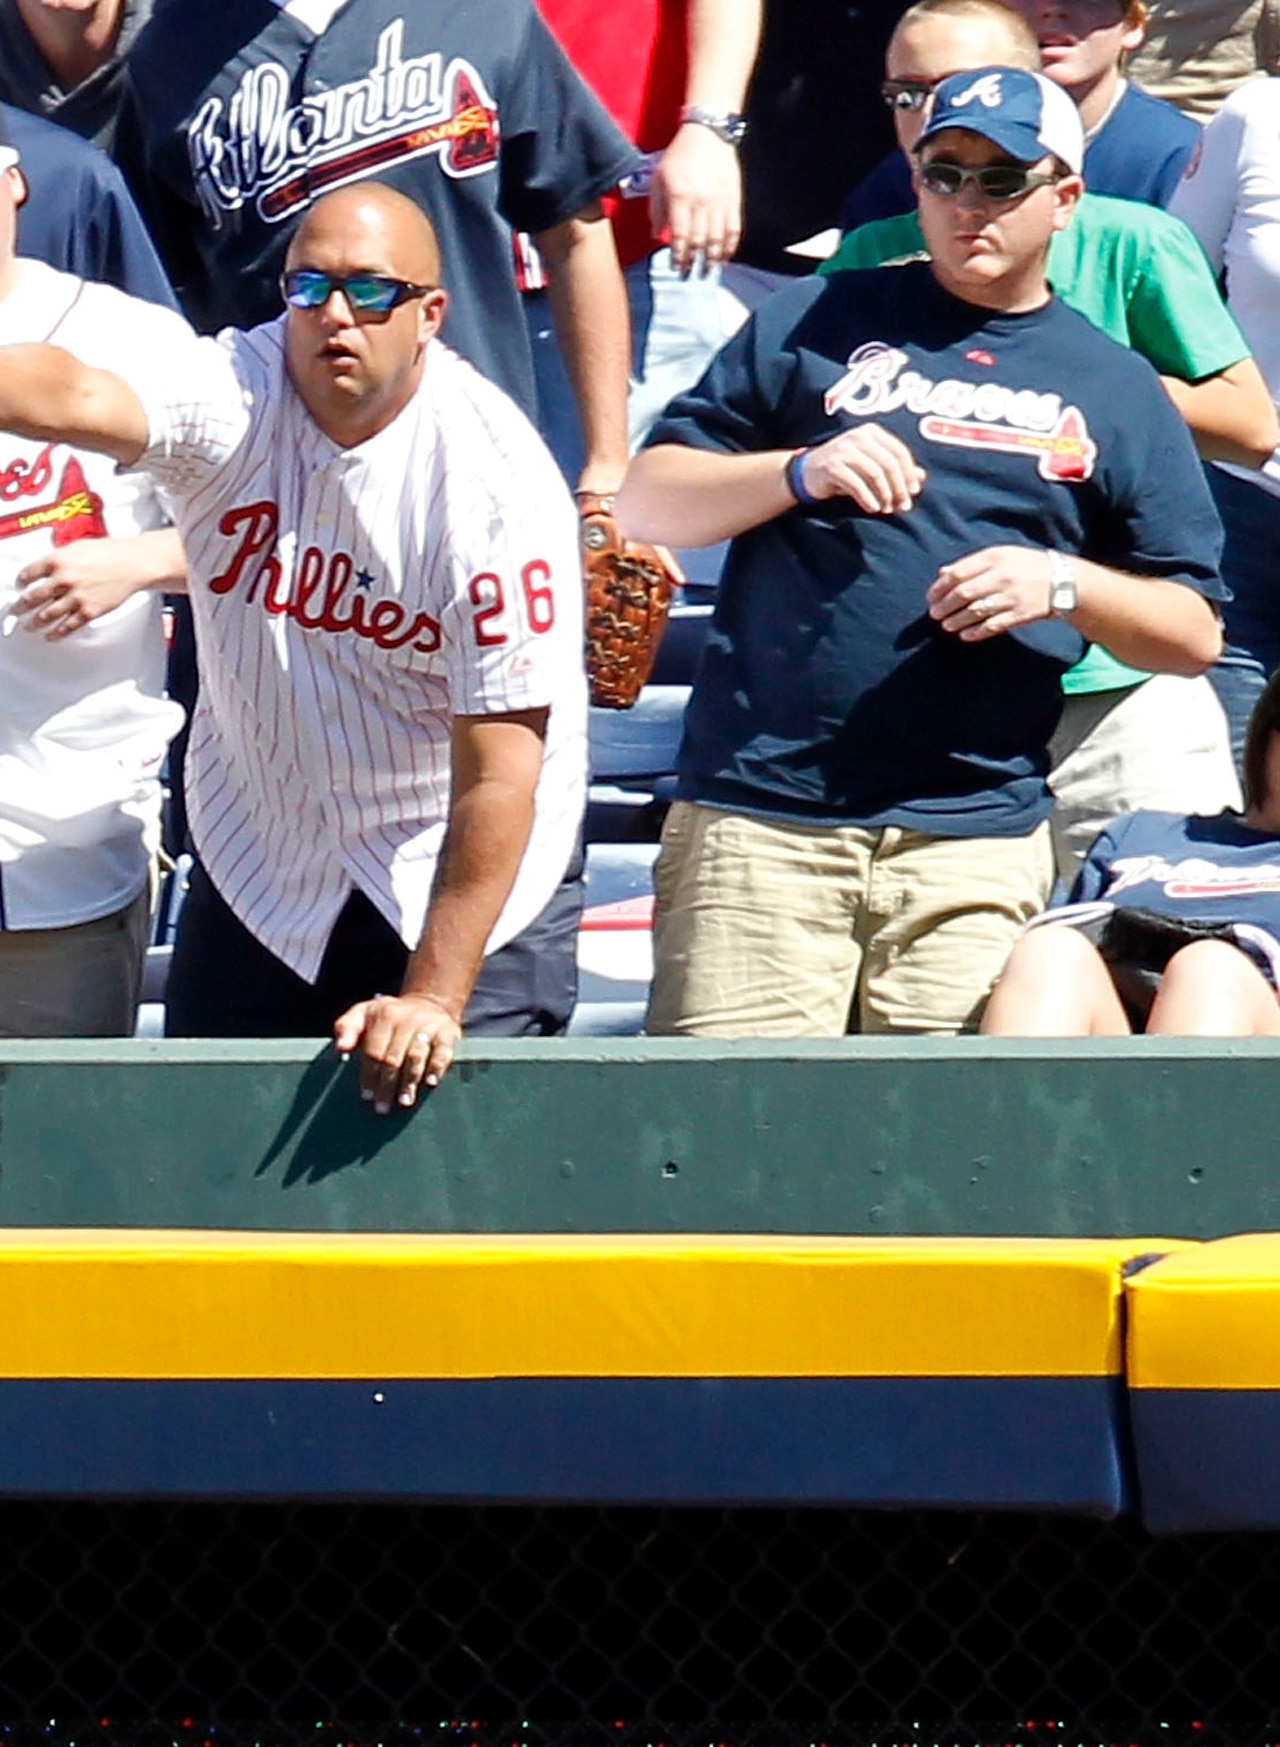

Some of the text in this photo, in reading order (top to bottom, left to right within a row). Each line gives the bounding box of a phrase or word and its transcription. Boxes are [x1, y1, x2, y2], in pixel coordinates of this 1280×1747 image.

[188, 17, 444, 231] Atlanta
[823, 340, 1063, 431] Braves
[208, 499, 445, 654] Phillies
[467, 557, 557, 647] 26
